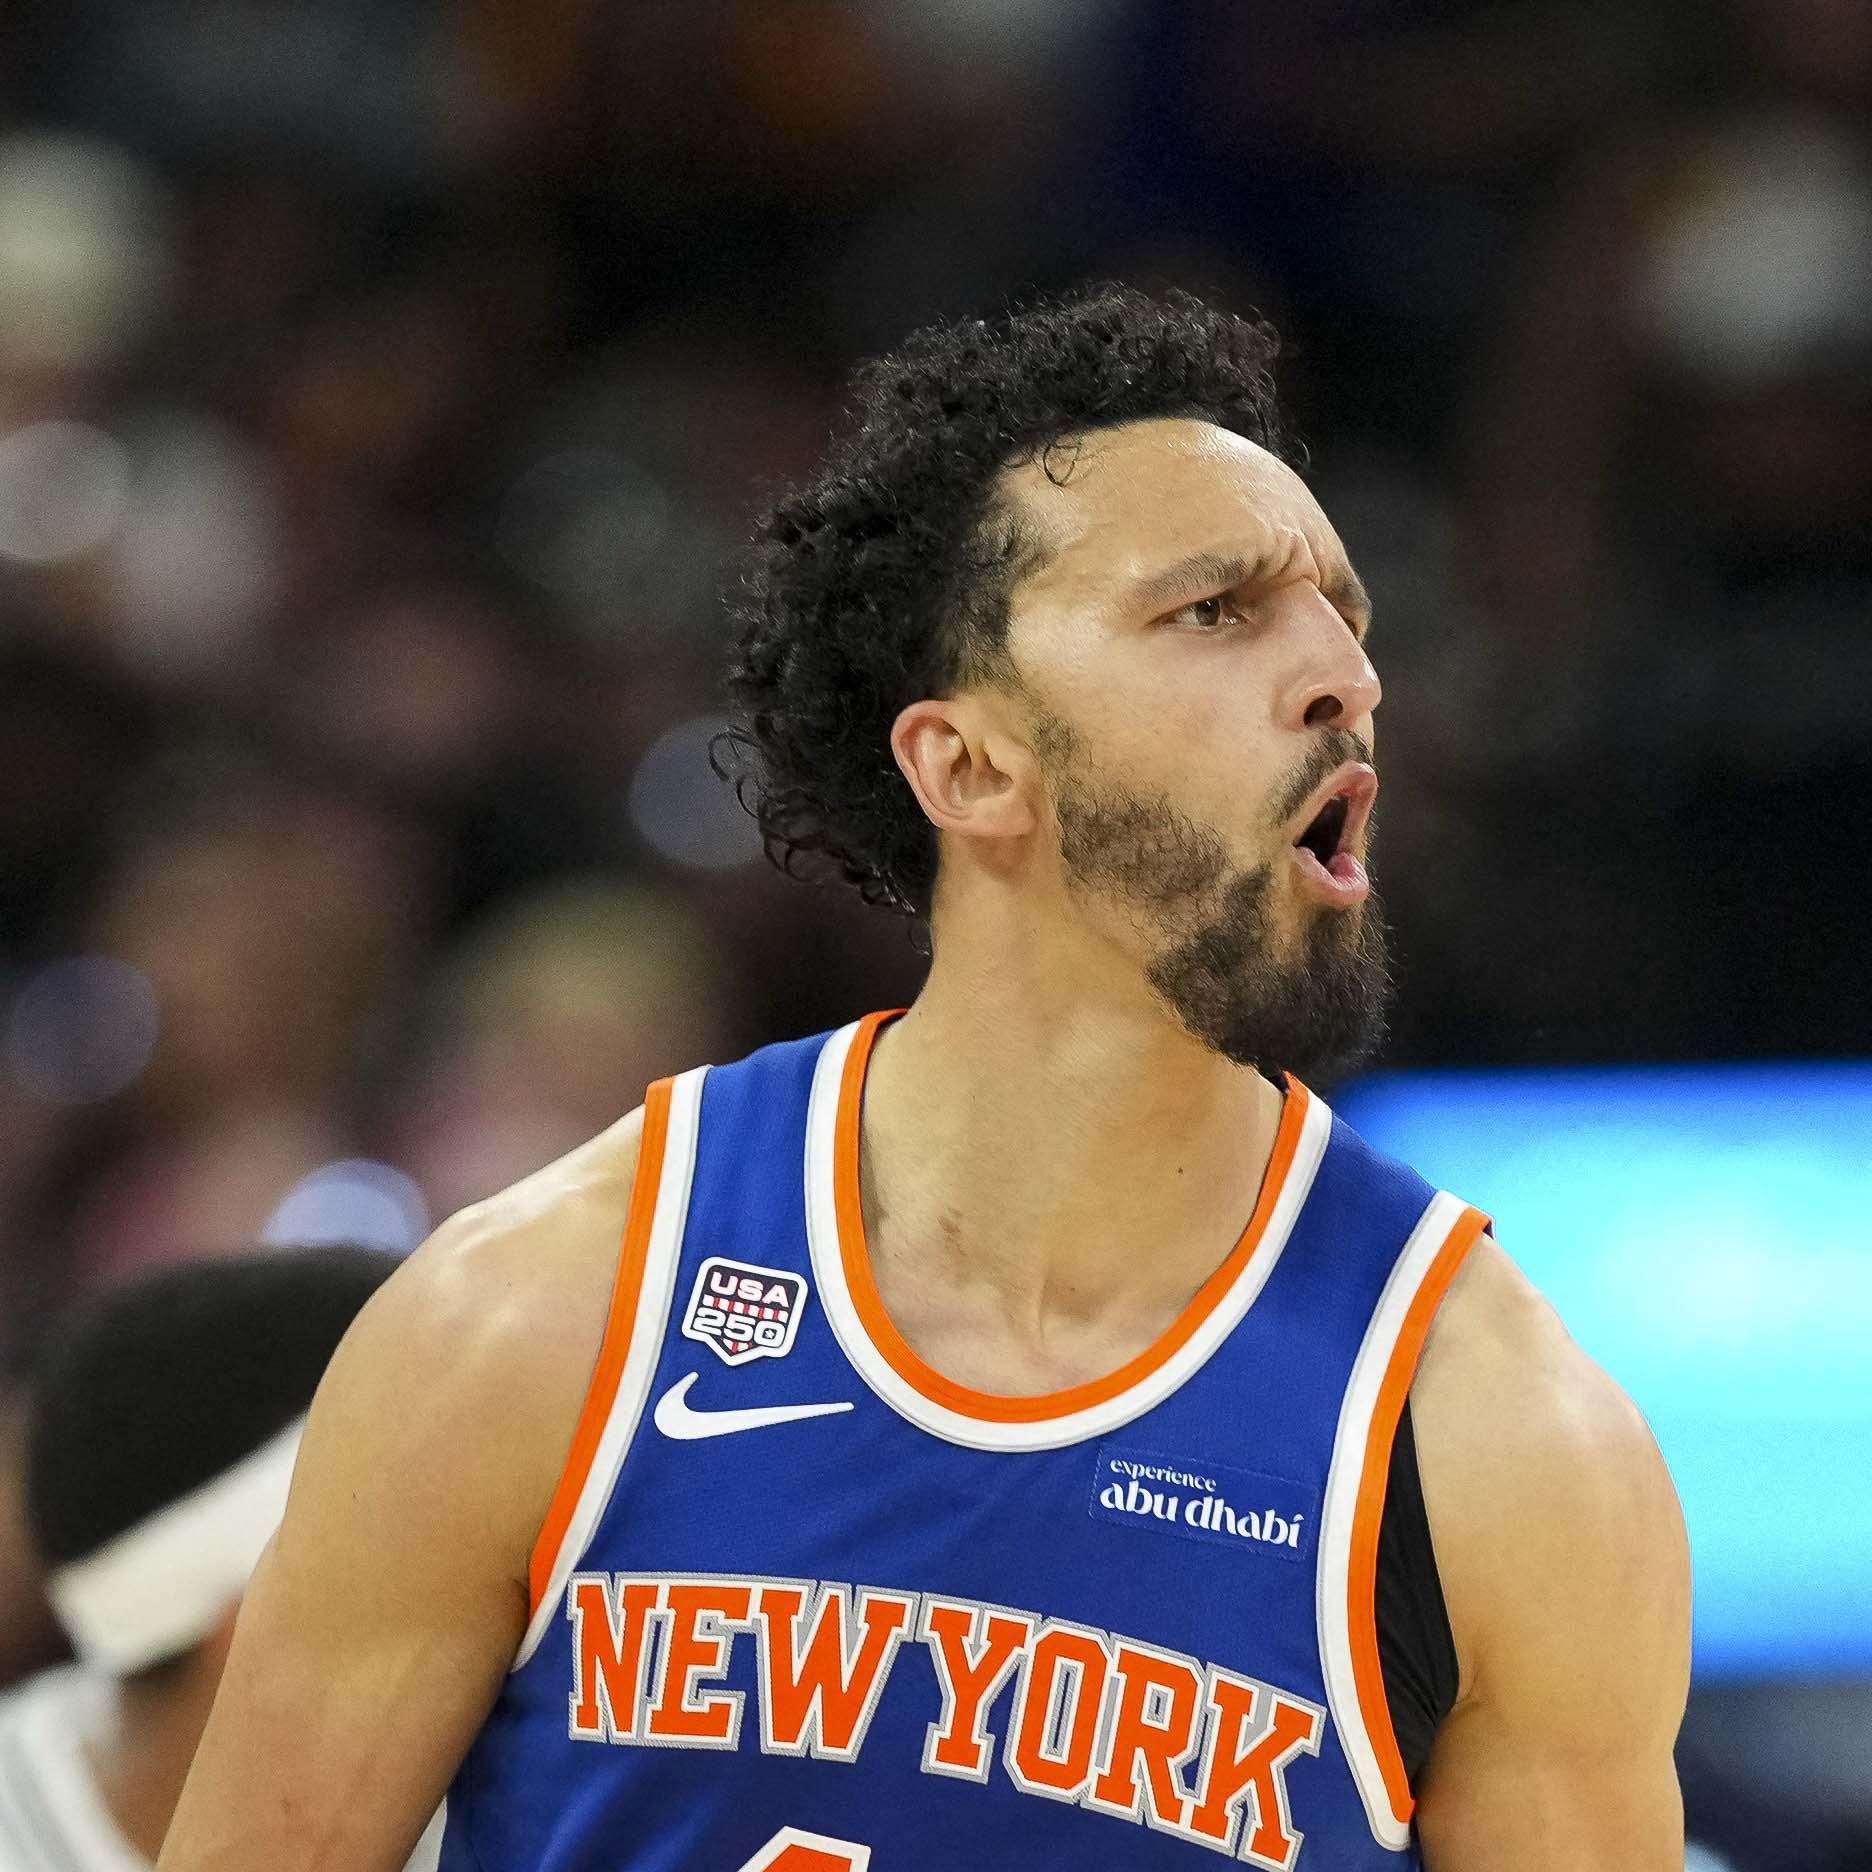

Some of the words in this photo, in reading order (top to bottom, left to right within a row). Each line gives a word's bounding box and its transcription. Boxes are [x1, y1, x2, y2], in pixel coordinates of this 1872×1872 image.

[710, 1271, 790, 1308] USA
[692, 1306, 787, 1349] 250
[1109, 1458, 1218, 1492] experience
[1099, 1480, 1179, 1522] abu
[1184, 1495, 1305, 1549] dhabi
[568, 1572, 921, 1759] NEW
